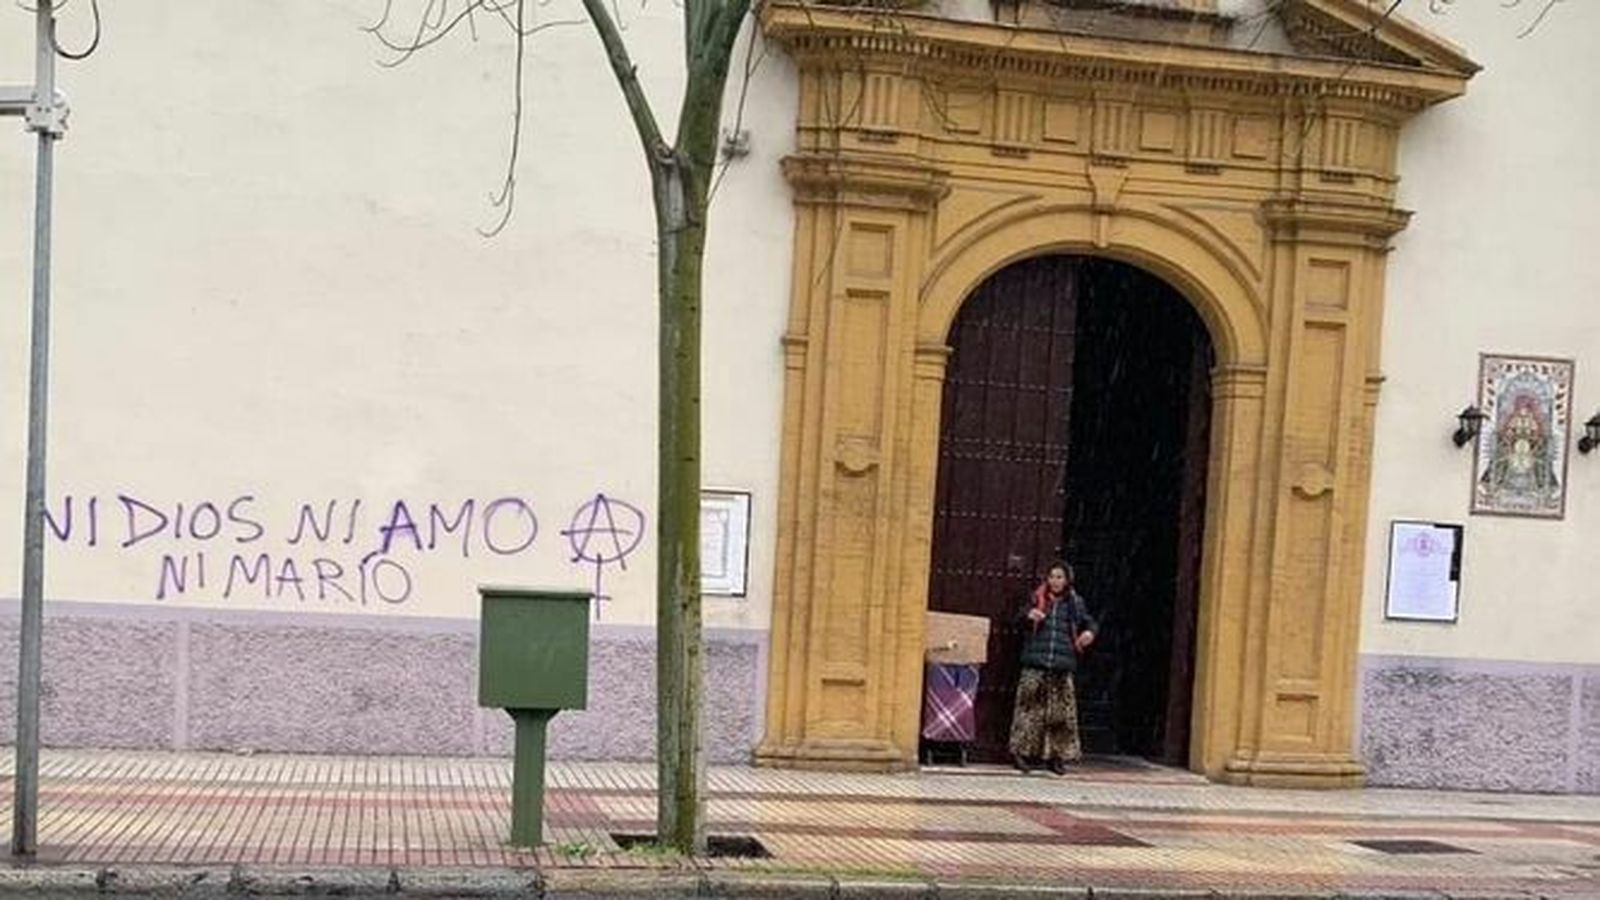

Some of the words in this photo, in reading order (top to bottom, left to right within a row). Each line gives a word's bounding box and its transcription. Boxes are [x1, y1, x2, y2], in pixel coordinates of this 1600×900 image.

[42, 495, 97, 547] NI
[117, 494, 264, 548] DIOS
[287, 499, 361, 544] NI
[379, 497, 538, 558] AMO
[156, 552, 204, 600] NI
